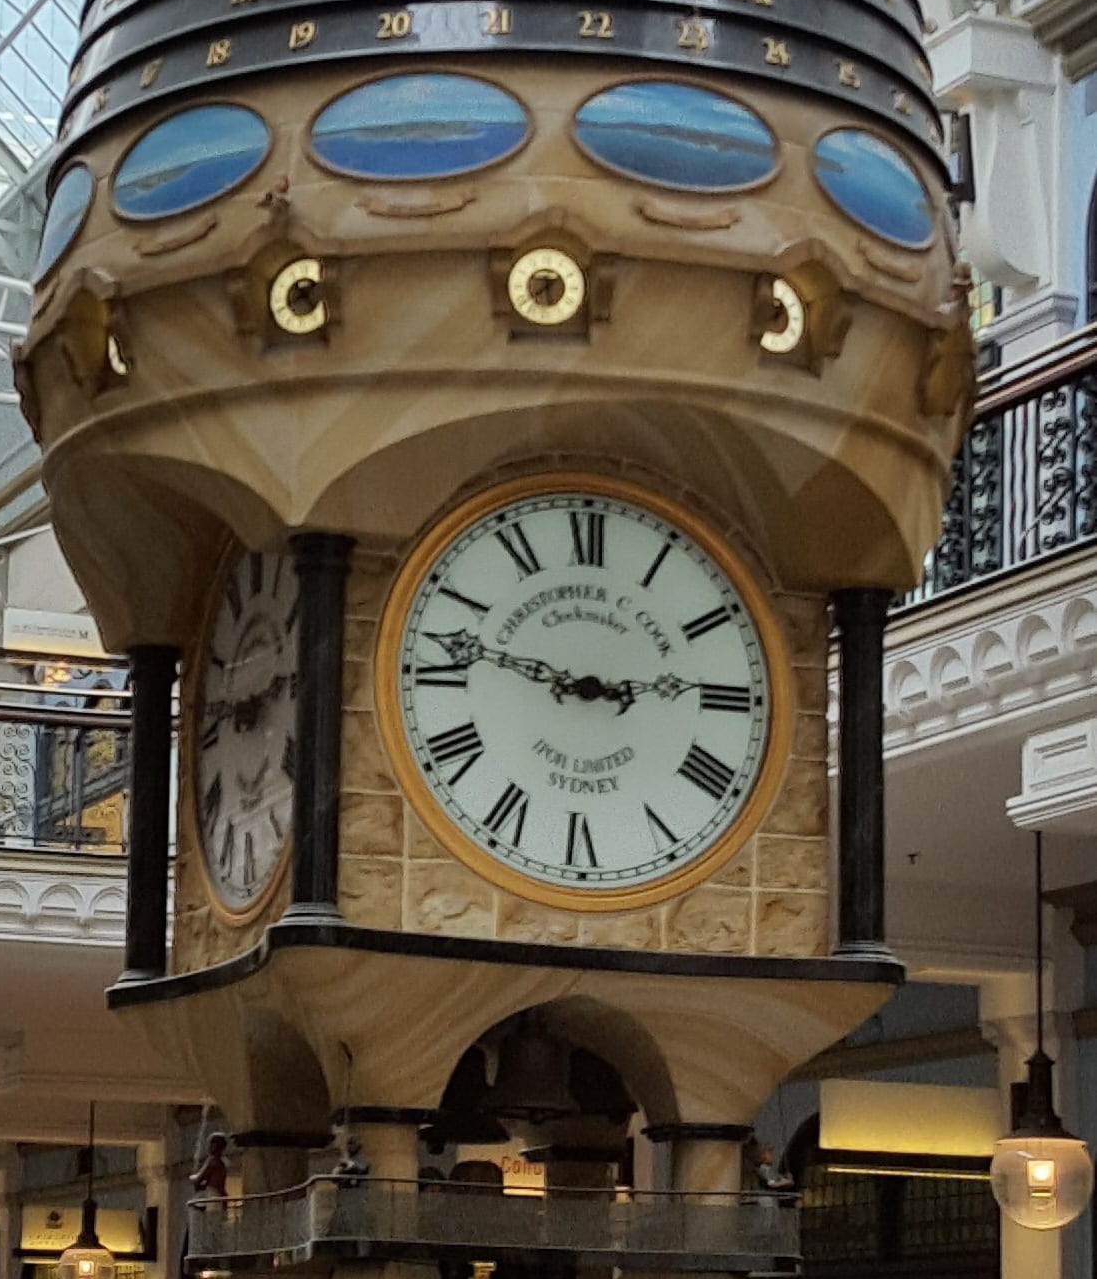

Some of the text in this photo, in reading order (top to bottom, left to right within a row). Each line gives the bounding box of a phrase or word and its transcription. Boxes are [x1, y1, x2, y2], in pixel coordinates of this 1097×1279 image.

[289, 21, 317, 50] 19
[376, 11, 413, 39] 20
[483, 7, 511, 35] 21
[578, 10, 615, 39] 22
[207, 39, 232, 67] 18
[568, 510, 605, 568] XII
[640, 543, 673, 588] I
[495, 584, 607, 645] CHRISTOPHER
[635, 611, 674, 659] COOK
[680, 605, 732, 643] II
[573, 746, 635, 773] LIMITED
[546, 771, 620, 794] SYDNEY
[563, 810, 601, 867] VI
